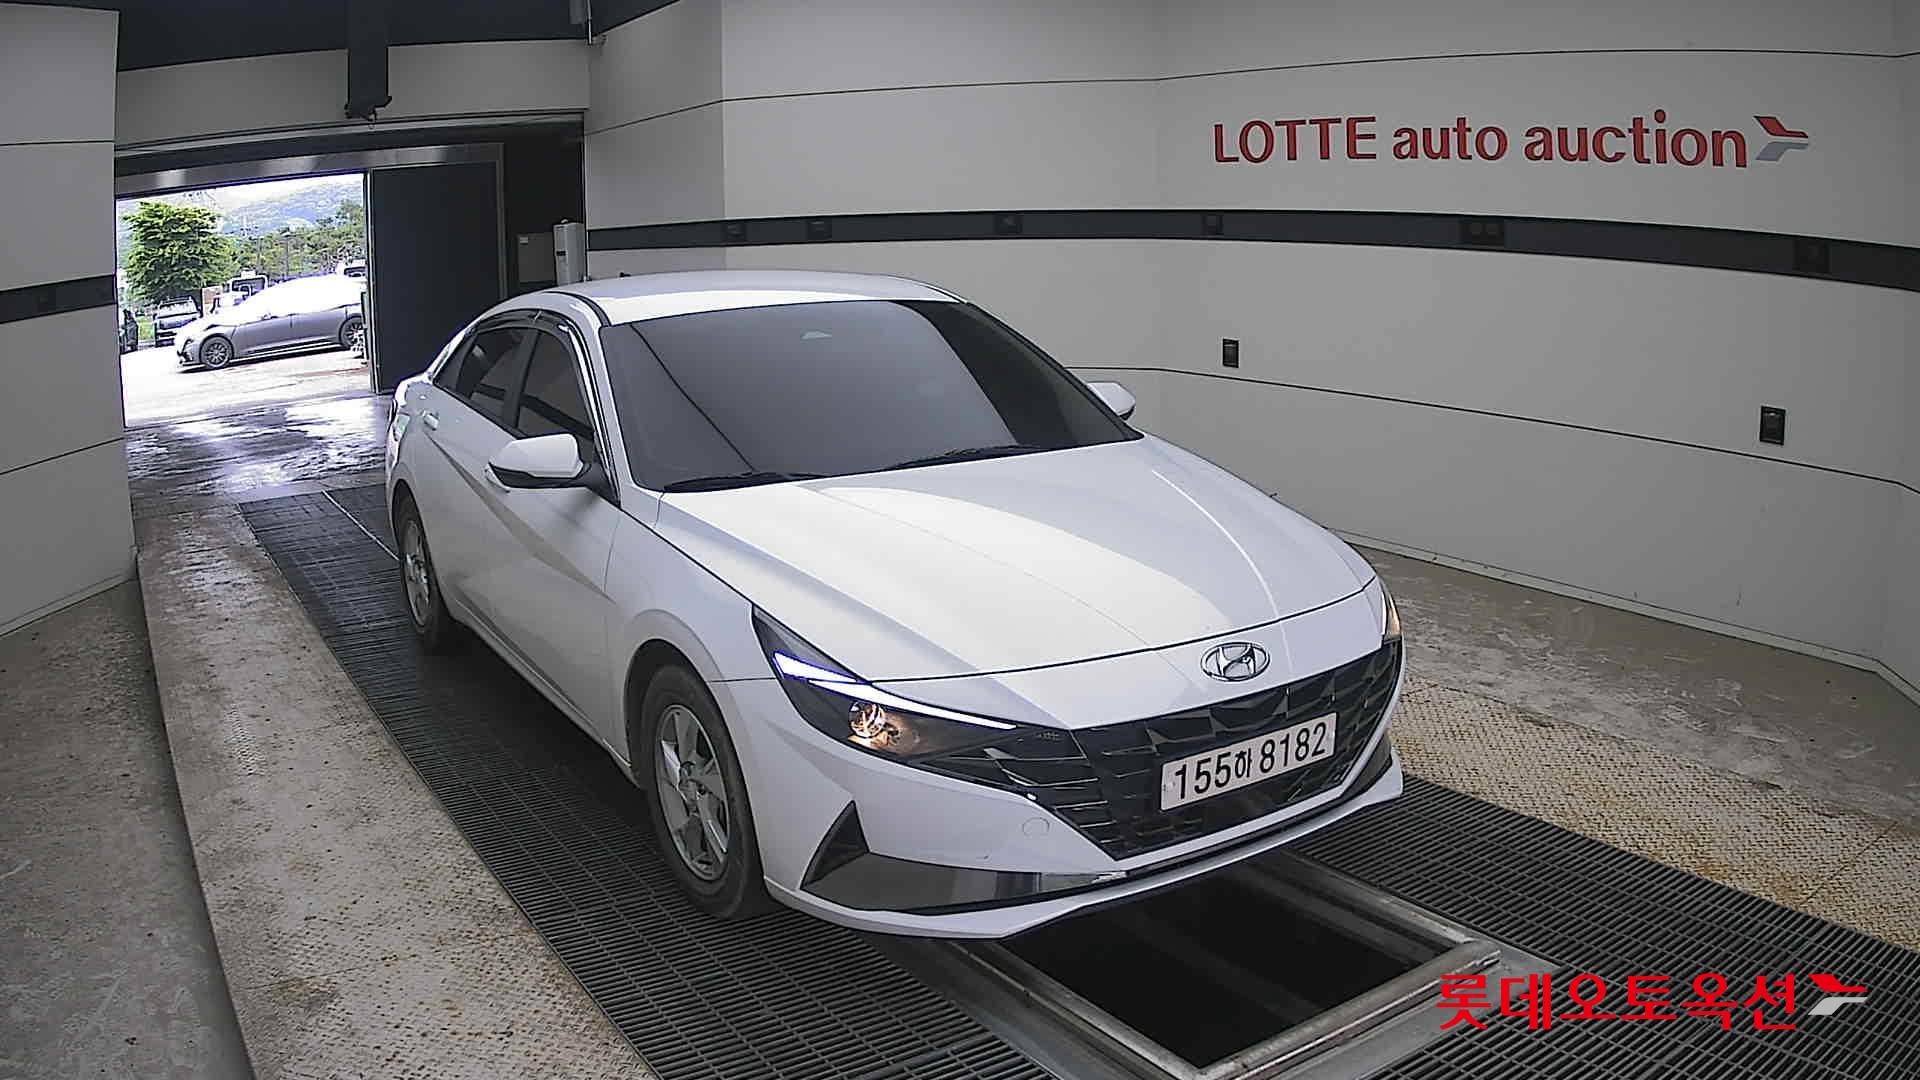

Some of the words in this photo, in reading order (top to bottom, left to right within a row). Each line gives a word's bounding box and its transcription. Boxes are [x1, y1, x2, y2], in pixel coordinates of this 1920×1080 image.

[1214, 116, 1377, 163] LOTTE
[1392, 116, 1508, 160] auto
[1524, 109, 1747, 168] auction
[1175, 748, 1252, 800] 155하
[1259, 722, 1326, 774] 8182
